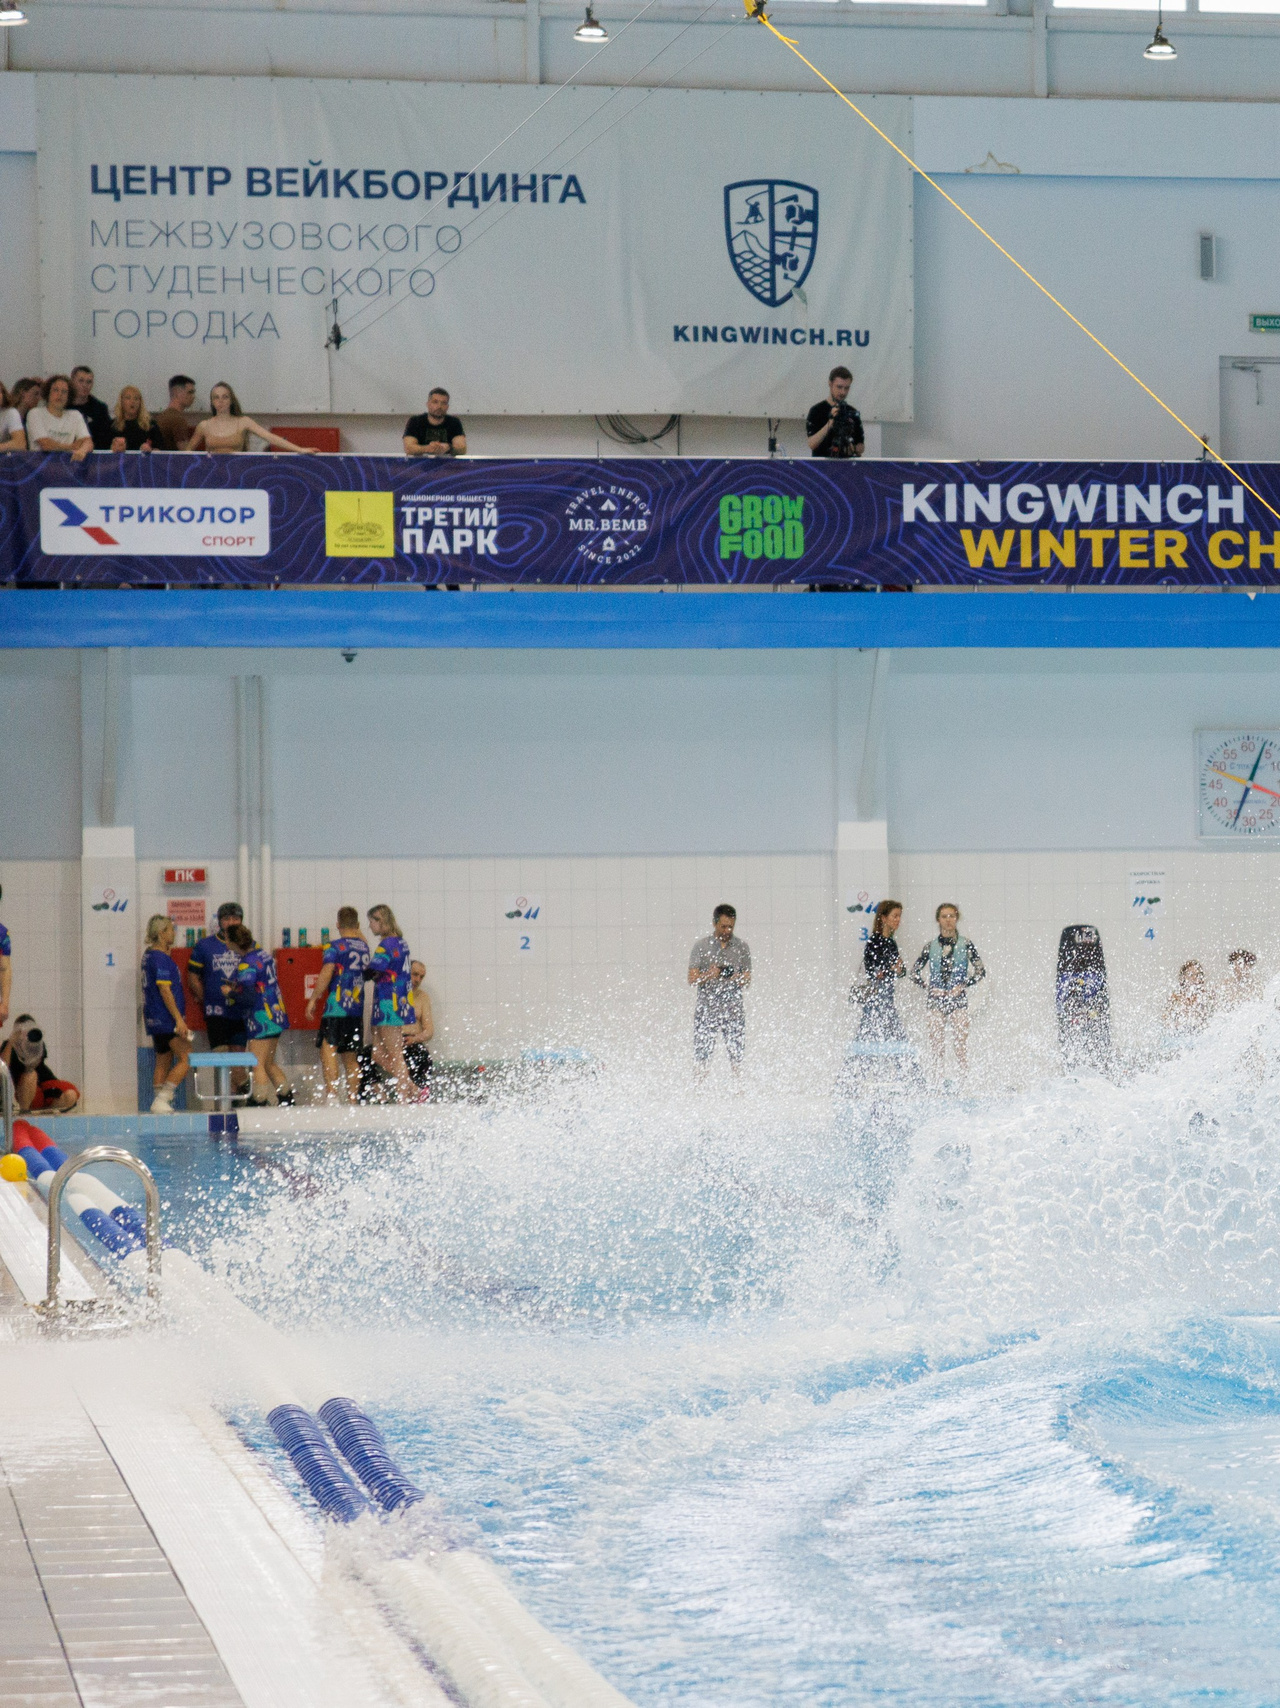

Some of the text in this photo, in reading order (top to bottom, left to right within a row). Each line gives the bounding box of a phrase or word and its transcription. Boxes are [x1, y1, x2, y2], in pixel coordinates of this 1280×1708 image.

[90, 159, 587, 209] ЦЕНТР ВЕЙКБОРДИНГА
[90, 220, 462, 254] МЕЖВУЗОВСКОГО
[91, 265, 436, 299] СТУДЕНЧЕСКОГО
[92, 310, 280, 344] ГОРОДКА
[673, 325, 871, 348] KINGWINCH.RU
[401, 494, 498, 503] АКЦИОНЕРНОЕ ОБЩЕСТВО
[565, 485, 651, 516] TRAVEL ENERGY
[902, 483, 1245, 523] KINGWINCH
[99, 506, 256, 524] ТРИКОЛОР
[401, 503, 498, 526] ТРЕТИЙ
[719, 494, 805, 535] GROW
[569, 518, 648, 532] MR.BEMB
[202, 535, 256, 547] СПОРТ
[402, 529, 498, 555] ПАРК
[719, 520, 805, 560] FOOD
[577, 543, 642, 564] SINCE 2022
[960, 528, 1188, 569] WINTER
[1241, 741, 1255, 752] 60
[1223, 749, 1238, 760] 55
[1265, 749, 1272, 760] 5
[1212, 761, 1226, 772] 50
[1208, 779, 1223, 790] 45
[1213, 797, 1228, 808] 40
[1242, 816, 1256, 827] 30
[1259, 809, 1273, 820] 25
[175, 869, 195, 881] ПК
[859, 927, 869, 941] 3
[1145, 927, 1155, 940] 4
[520, 936, 530, 950] 2
[105, 952, 115, 967] 1
